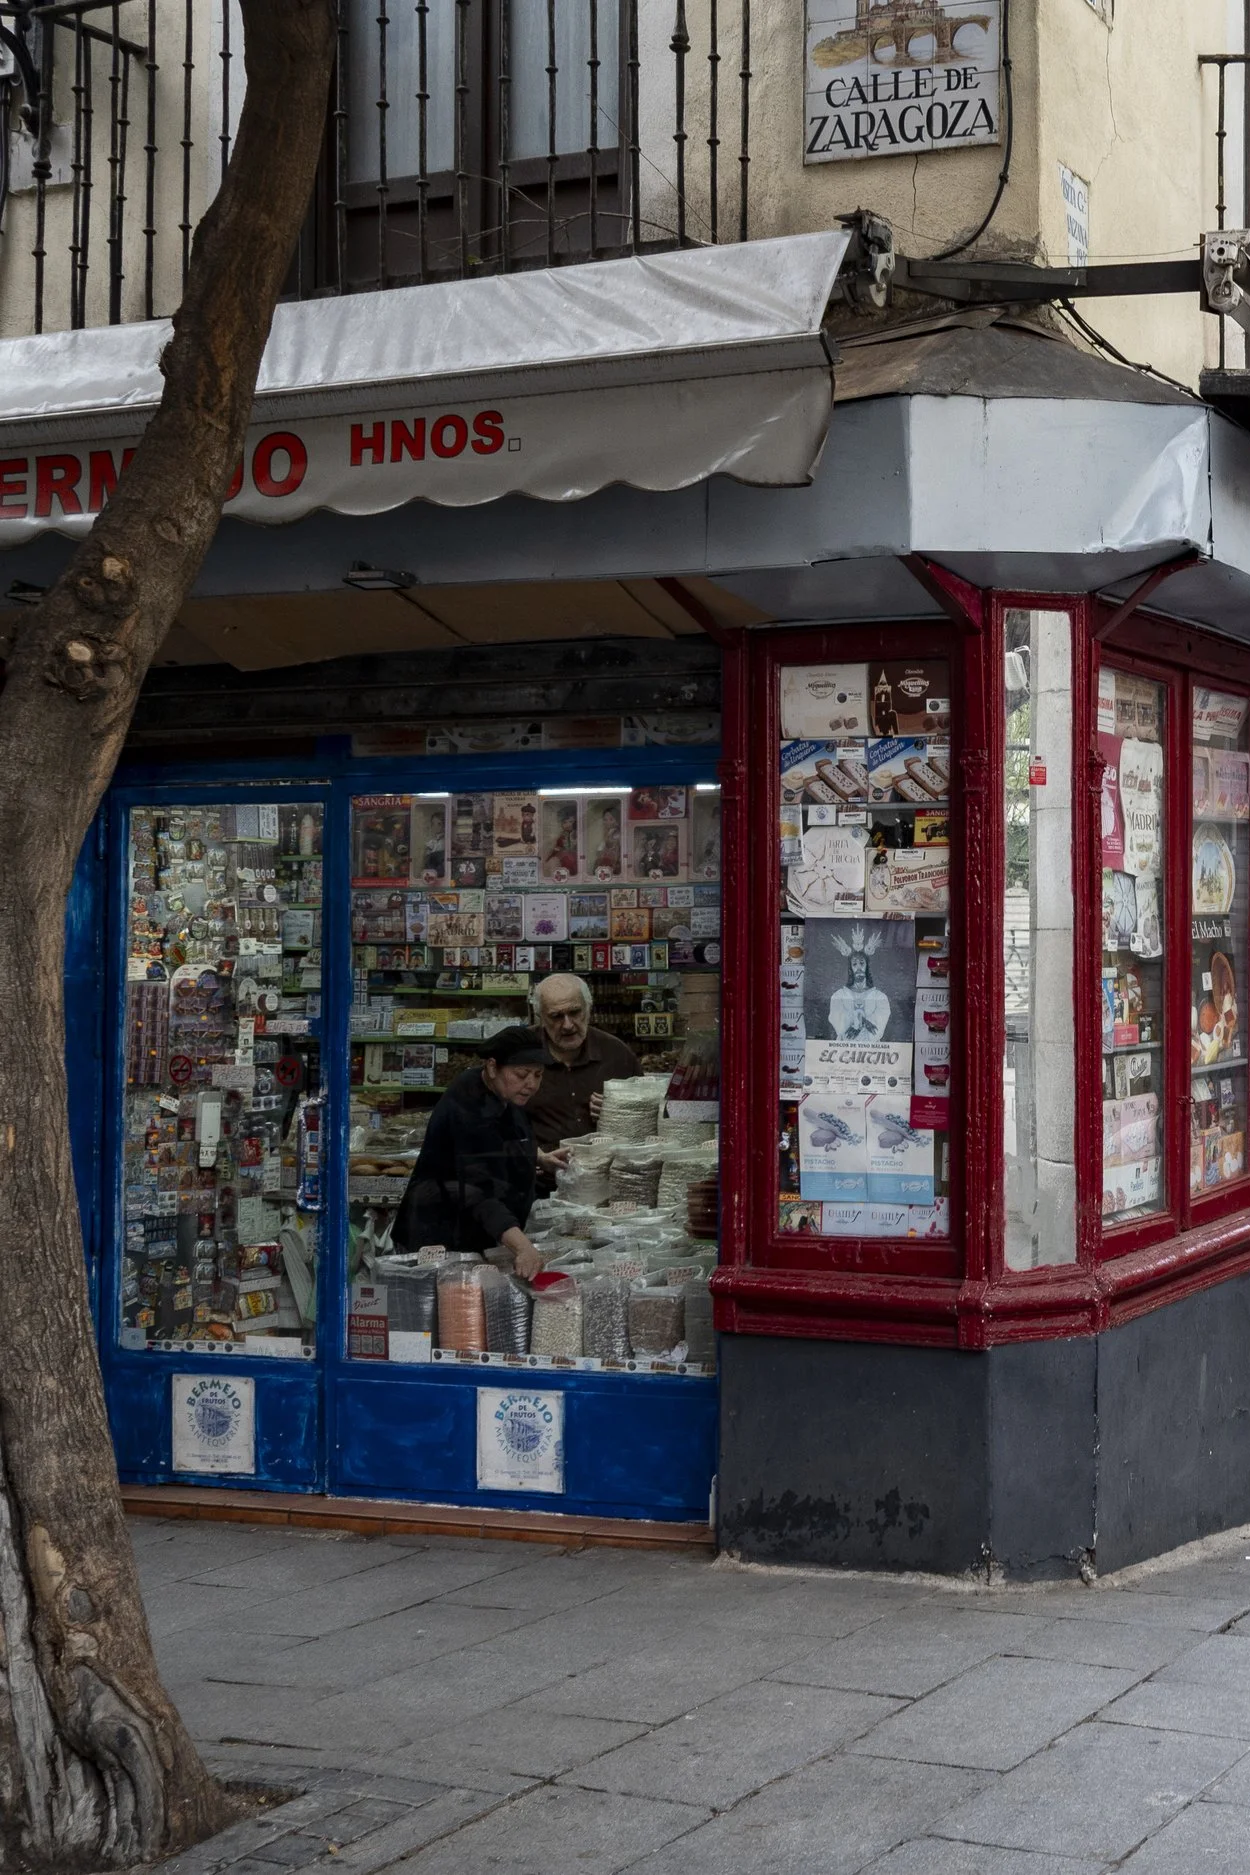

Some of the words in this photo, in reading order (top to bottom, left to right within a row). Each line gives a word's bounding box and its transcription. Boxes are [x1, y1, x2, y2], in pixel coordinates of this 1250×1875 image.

[826, 68, 938, 108] CALLE
[944, 66, 981, 92] DE
[806, 98, 997, 155] ZARAGOZA
[0, 431, 308, 519] ERMO
[350, 1316, 385, 1328] Alarma
[186, 1379, 242, 1410] BERMEJO
[495, 1394, 553, 1424] BERMEJO
